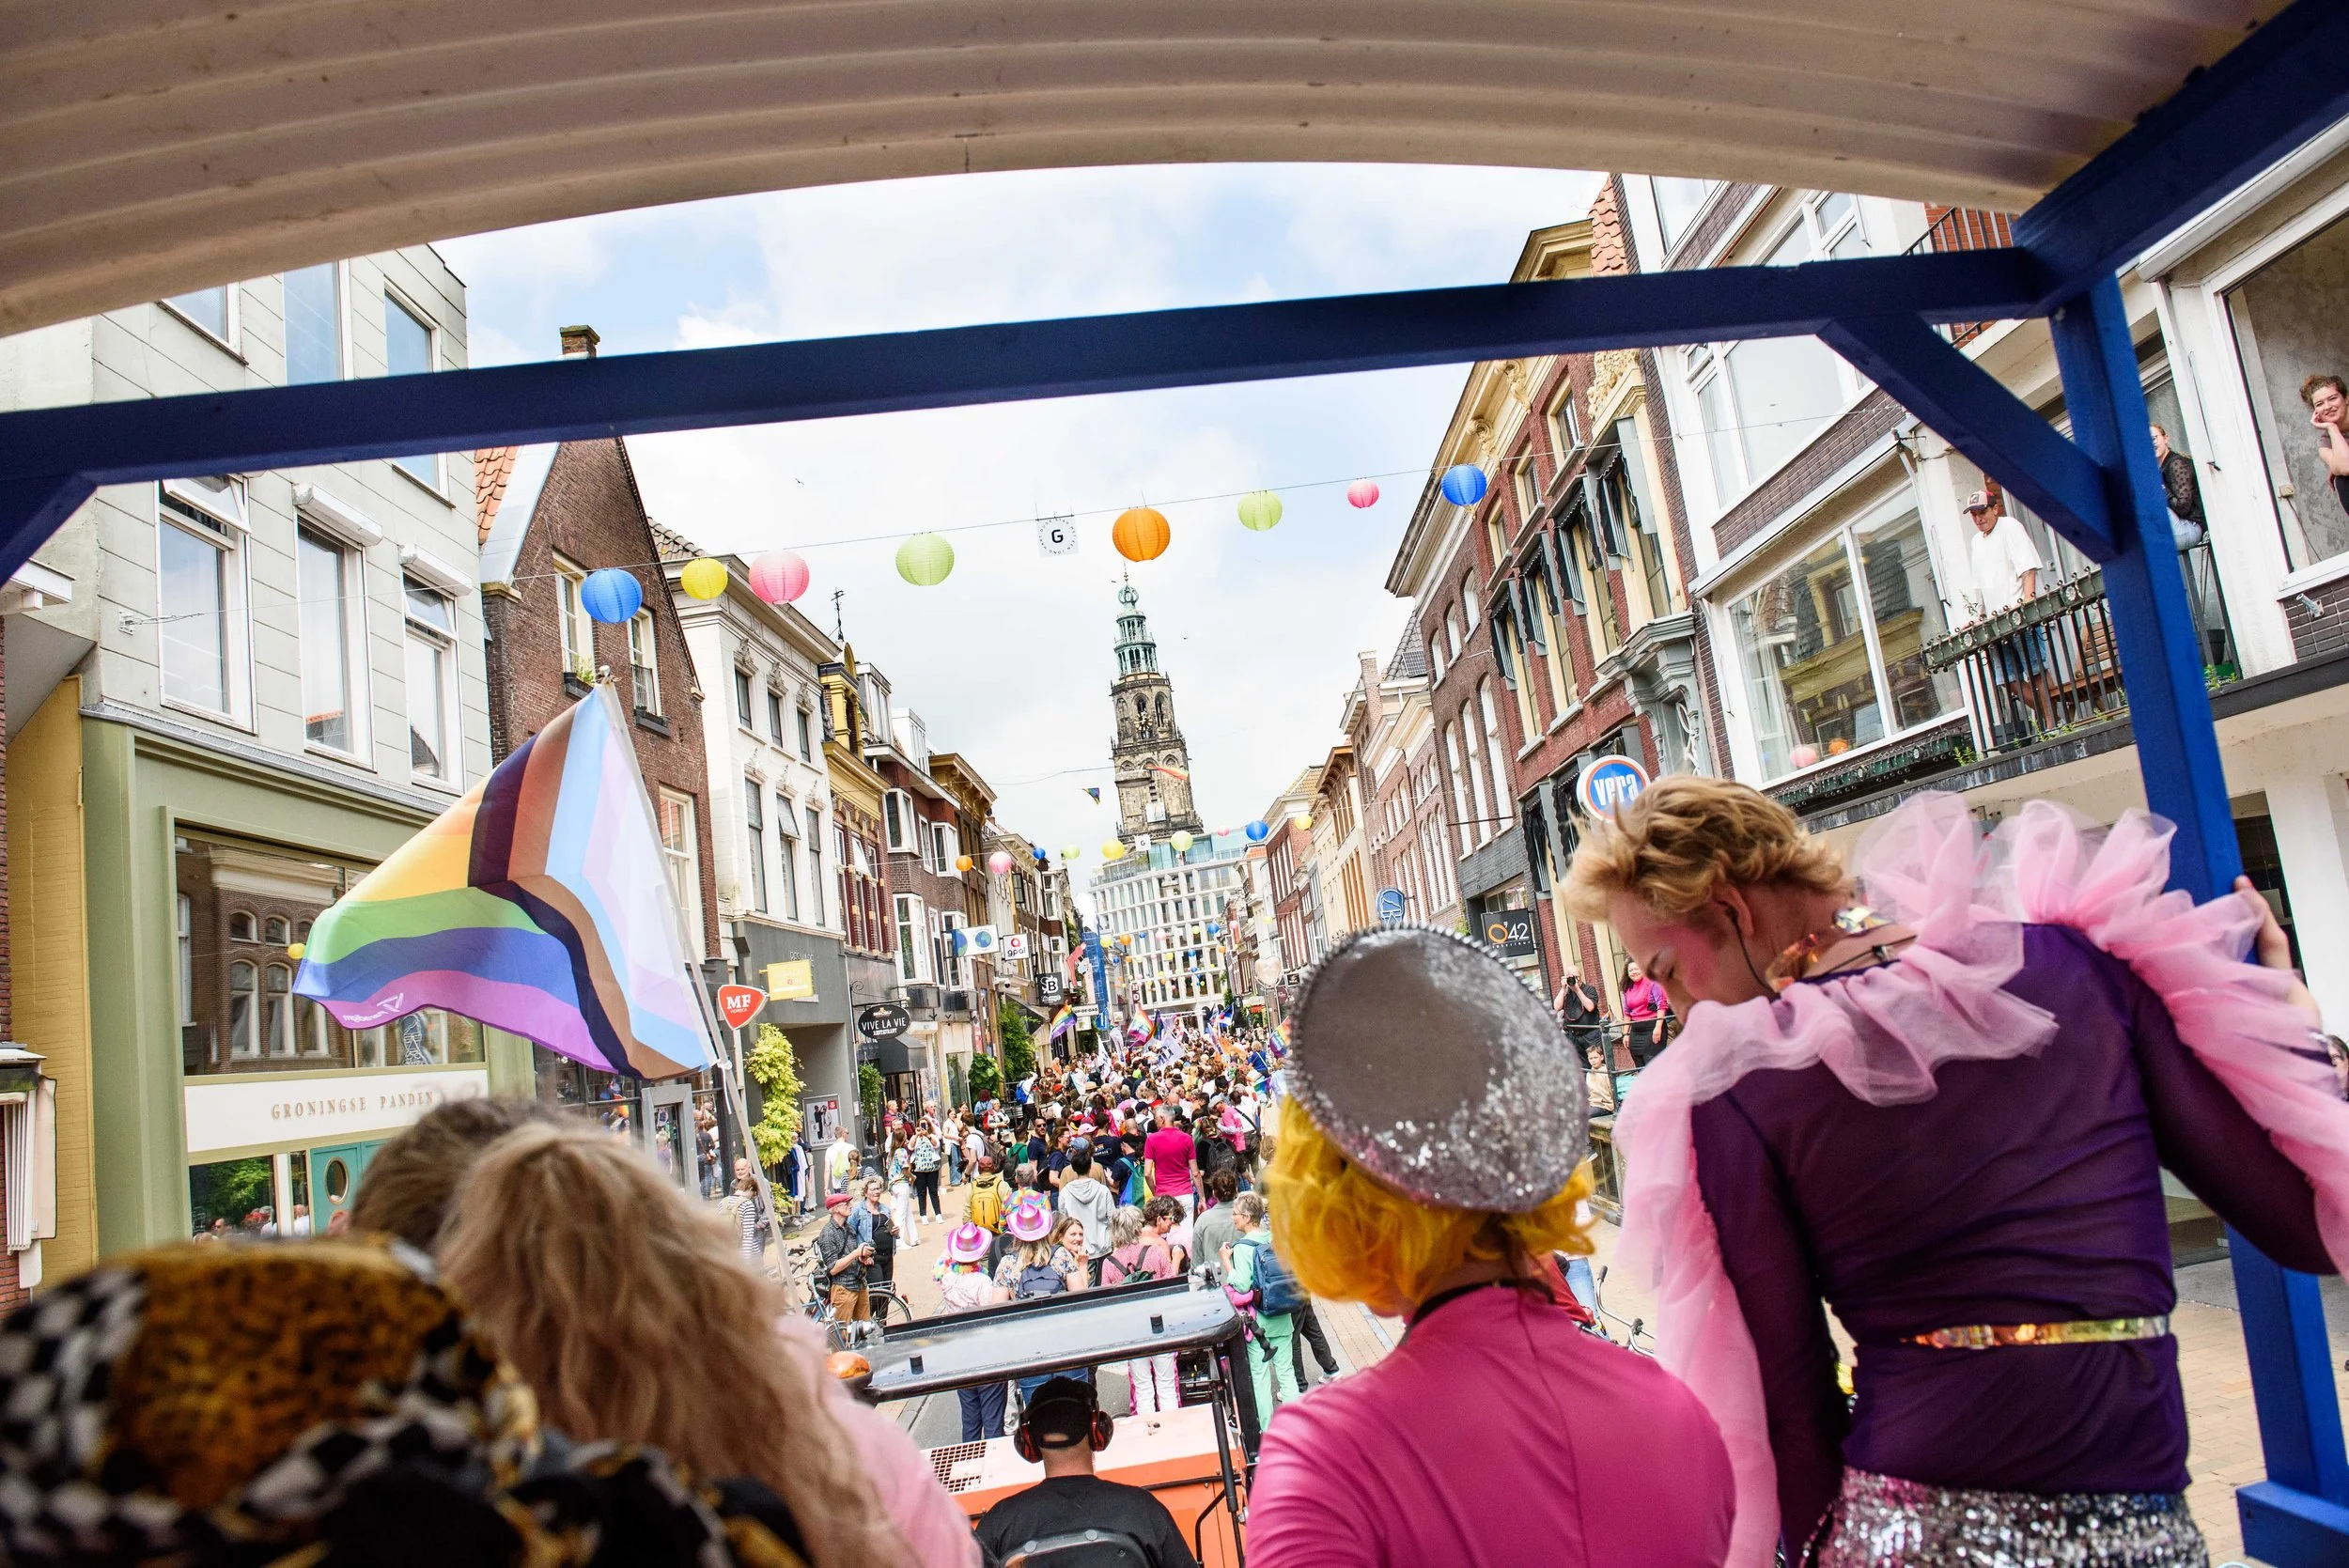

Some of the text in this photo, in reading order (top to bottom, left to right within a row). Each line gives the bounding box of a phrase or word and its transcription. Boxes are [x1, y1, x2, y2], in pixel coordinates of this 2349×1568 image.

[1051, 529, 1064, 543] G
[1594, 774, 1639, 806] vera
[726, 995, 751, 1009] MF
[862, 1017, 907, 1031] VIVE LA VIE
[271, 1090, 435, 1120] GRONINGSE PANDEN
